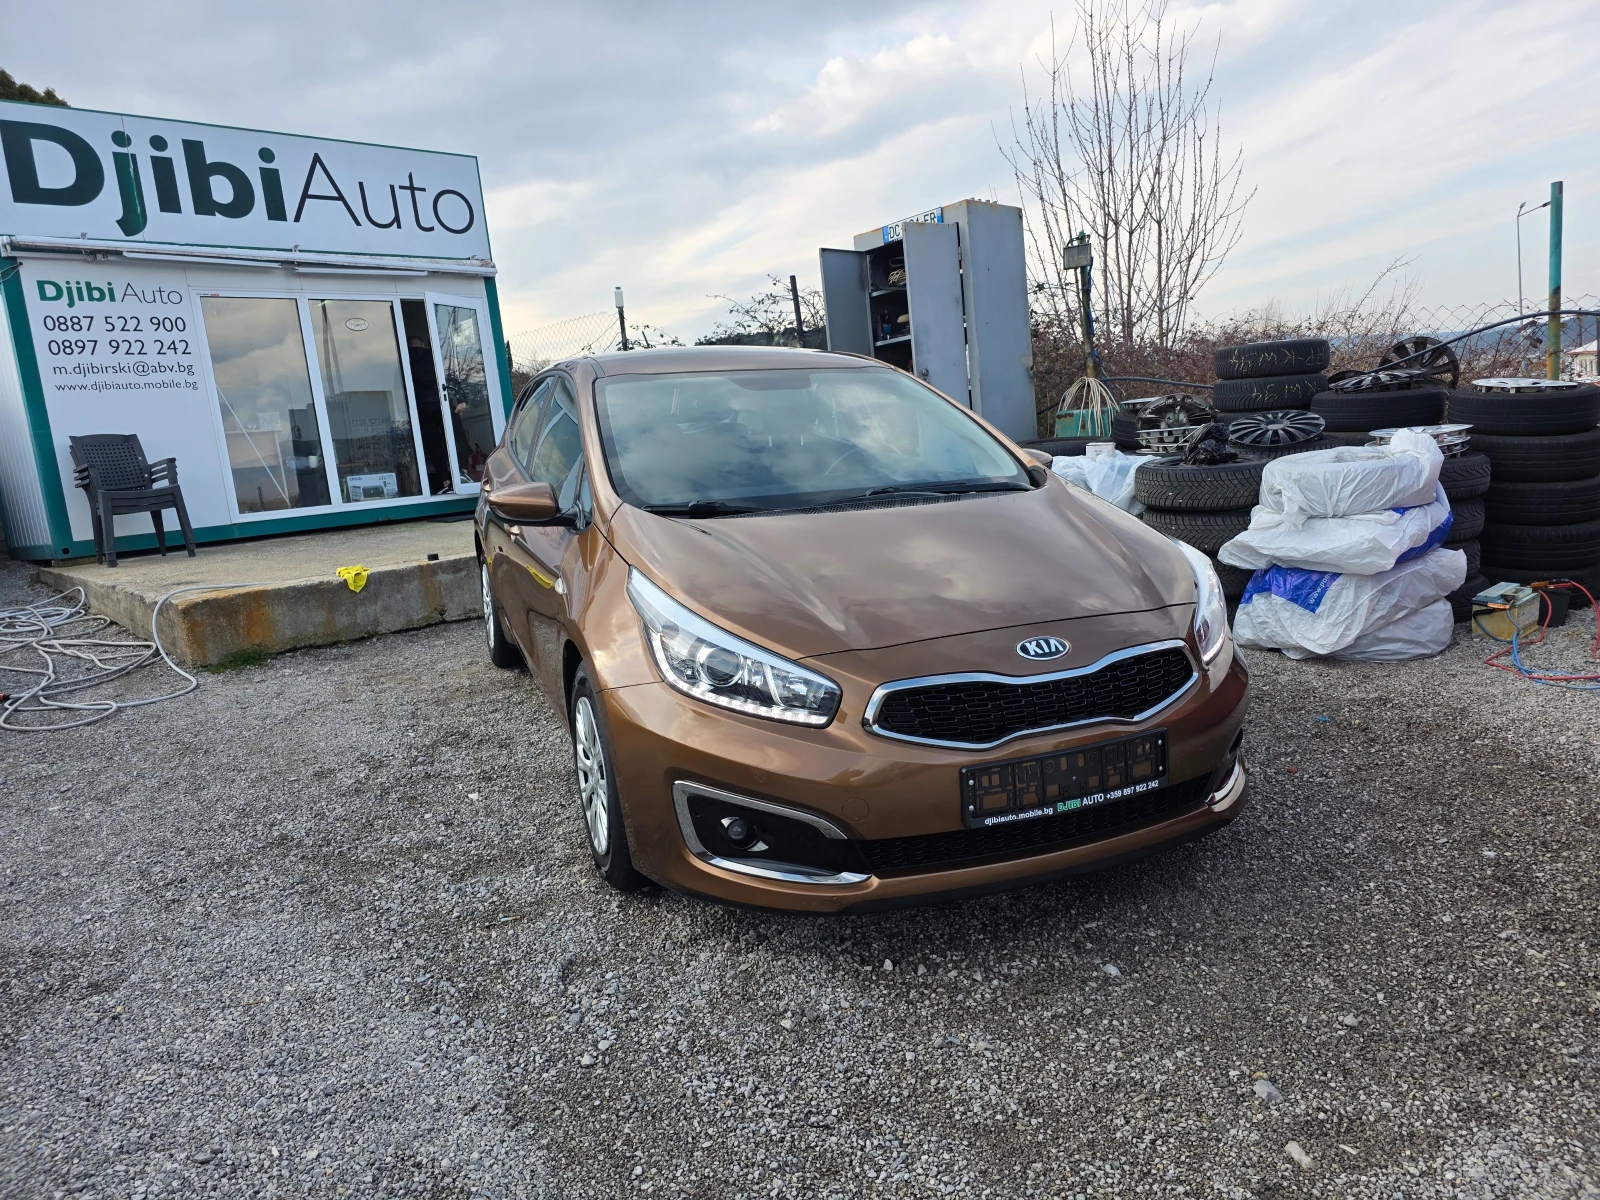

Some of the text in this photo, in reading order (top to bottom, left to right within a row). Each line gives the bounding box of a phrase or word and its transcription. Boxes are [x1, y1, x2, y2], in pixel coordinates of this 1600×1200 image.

[36, 280, 183, 308] Djibi Auto
[43, 315, 186, 332] 0887 522 900
[48, 339, 191, 356] 0897 922 242
[53, 361, 195, 378] m.djibirski@abv.bg
[55, 379, 199, 393] www.djibiauto.mobile.bg
[1023, 638, 1064, 656] KIA
[984, 779, 1159, 826] djibiauto.mobile.bg DJIBI AUTO +359 897 922 242
